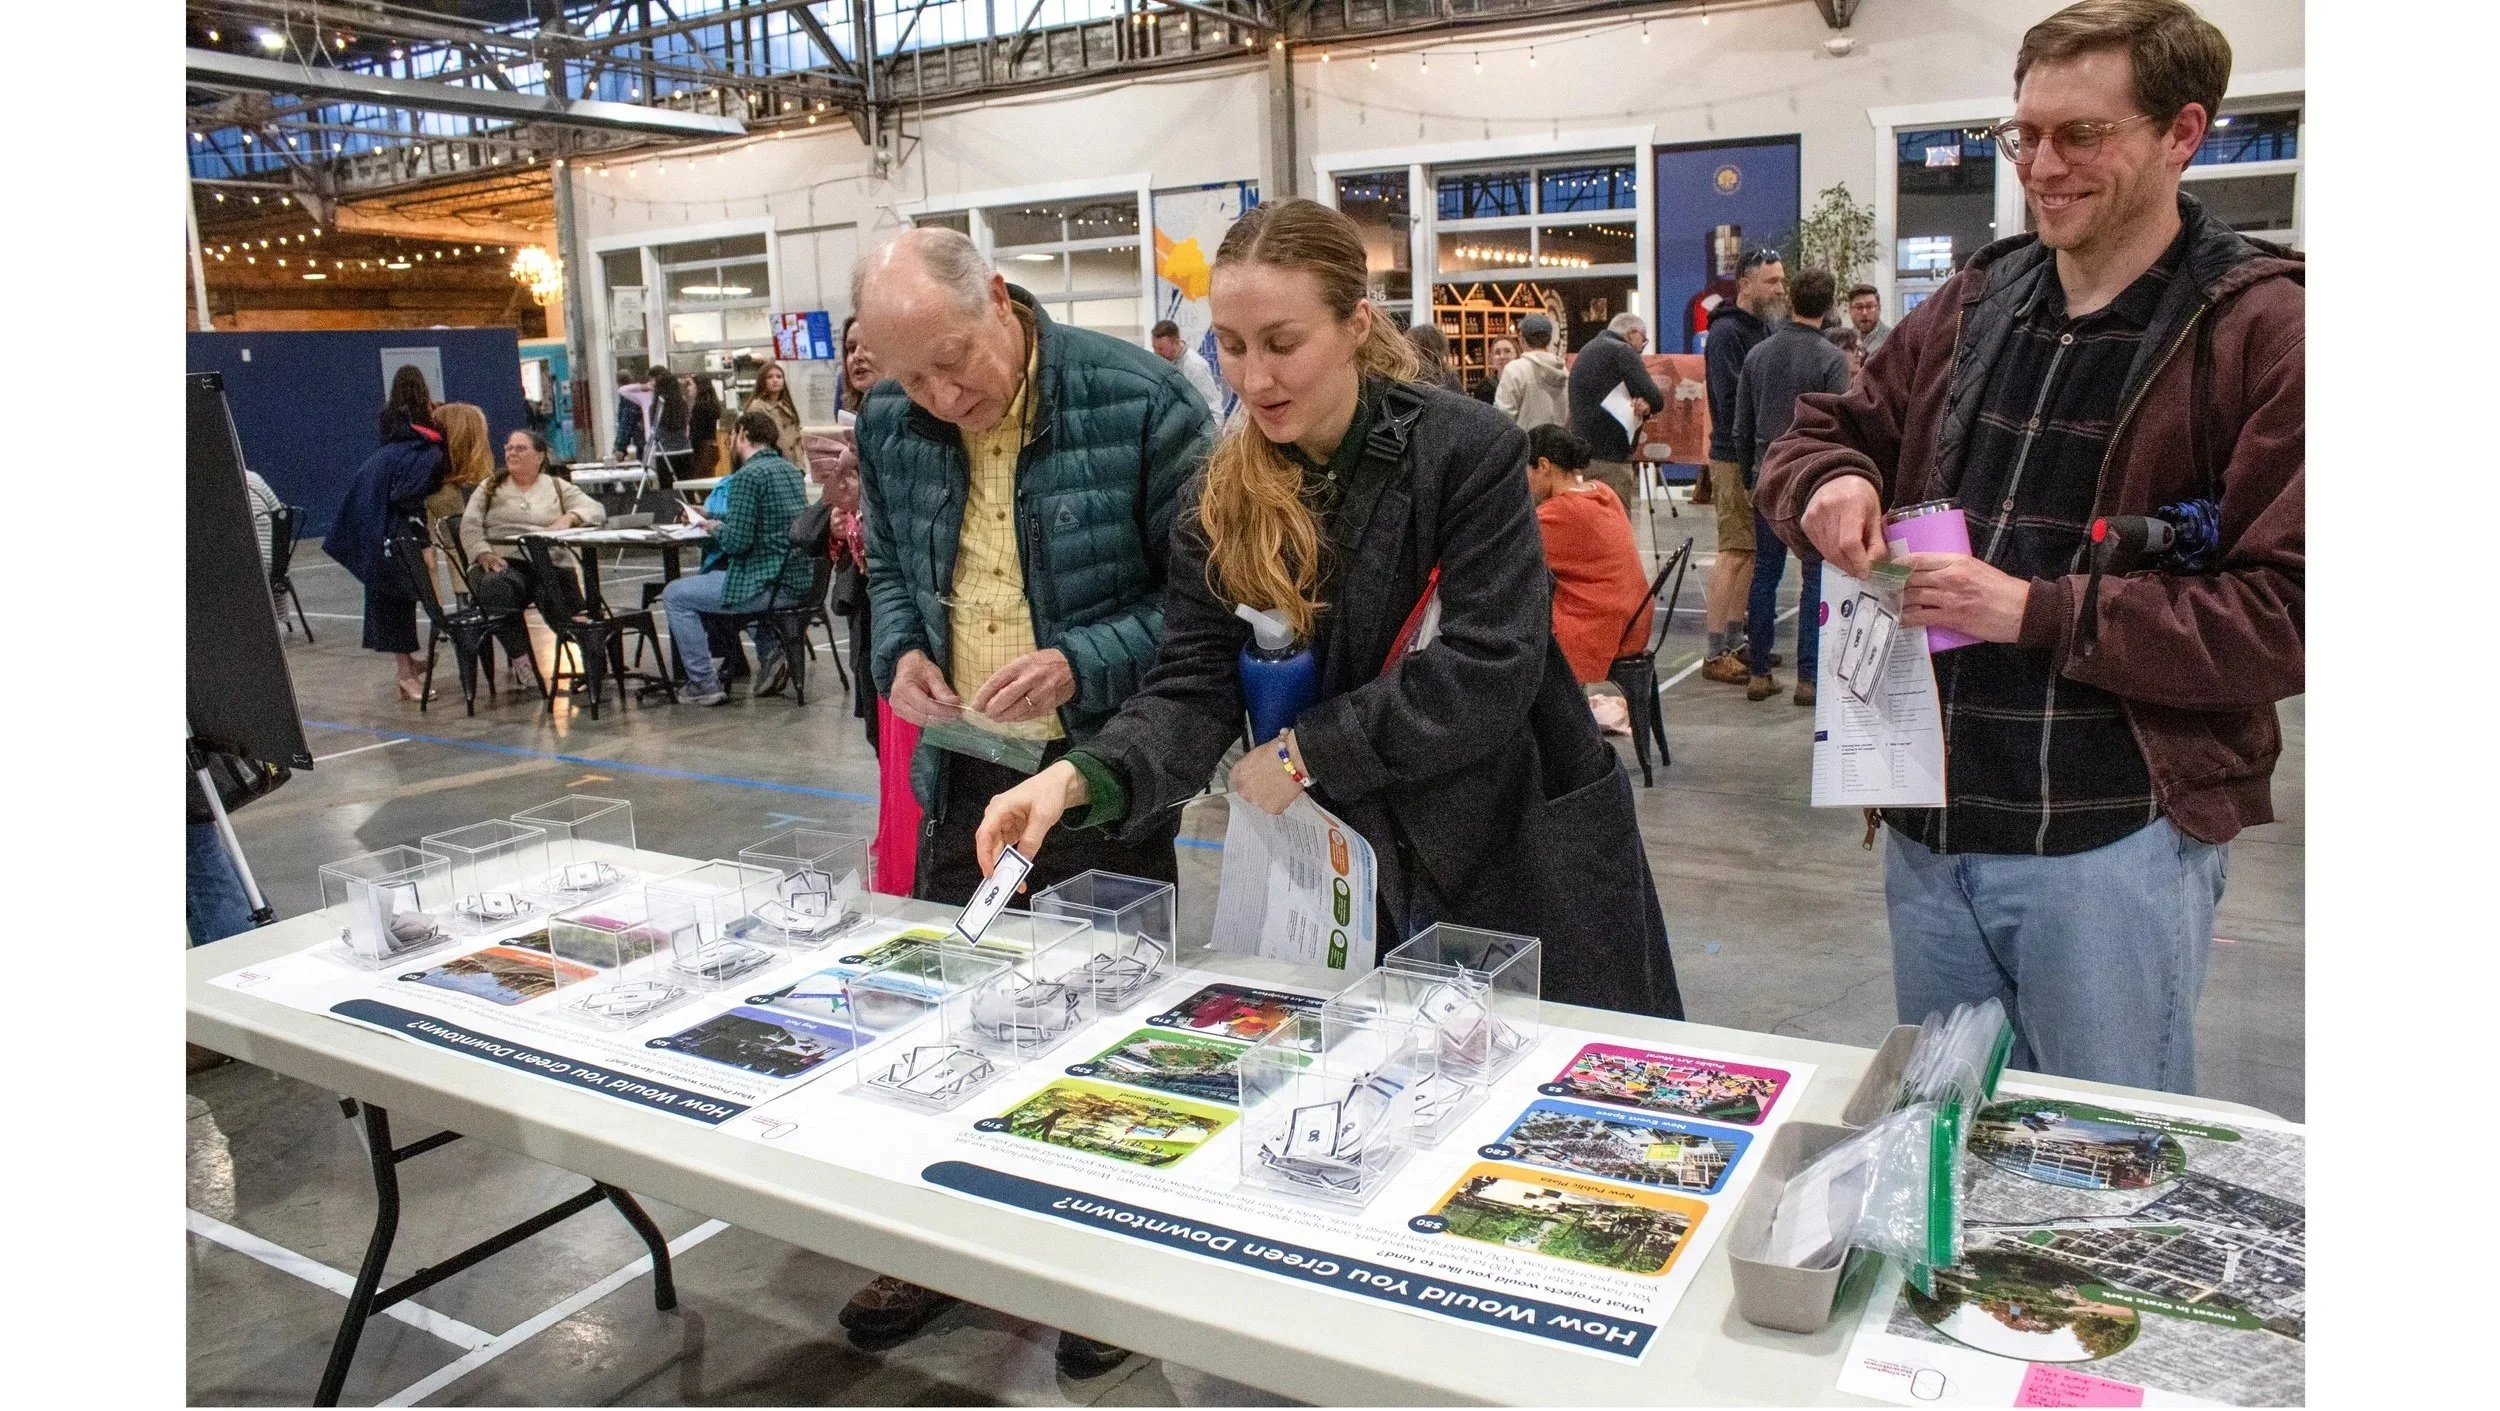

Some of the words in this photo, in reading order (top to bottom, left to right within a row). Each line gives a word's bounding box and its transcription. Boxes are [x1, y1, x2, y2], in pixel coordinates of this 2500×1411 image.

[983, 885, 1001, 907] $10
[1251, 990, 1290, 1000] Sculpture
[1152, 1016, 1172, 1024] $10
[407, 1018, 515, 1058] Downtown?
[513, 1051, 571, 1074] Green
[1646, 1053, 1674, 1061] Mural
[1072, 1066, 1093, 1074] $30
[1695, 1061, 1725, 1069] Public
[570, 1068, 608, 1084] You
[605, 1078, 678, 1104] Would
[1119, 1092, 1170, 1106] Playground
[676, 1097, 734, 1119] How
[1595, 1110, 1626, 1119] Space
[1629, 1116, 1658, 1125] Event
[981, 1121, 1003, 1130] $10
[1661, 1121, 1687, 1129] New
[2163, 1126, 2208, 1136] Refresh
[1485, 1148, 1510, 1156] $80
[1085, 1169, 1111, 1179] With
[1540, 1177, 1569, 1186] Plaza
[1571, 1183, 1605, 1194] Public
[1608, 1190, 1635, 1199] New
[1257, 1209, 1291, 1222] space
[1052, 1196, 1237, 1251] Downtown?
[1294, 1218, 1325, 1230] open
[1415, 1219, 1443, 1229] $50
[1327, 1227, 1351, 1237] and
[1355, 1232, 1382, 1244] park
[1383, 1239, 1426, 1254] toward
[1402, 1234, 1440, 1248] spend
[1429, 1247, 1470, 1263] spend
[1443, 1242, 1483, 1256] would
[1242, 1243, 1340, 1277] Green
[1376, 1249, 1415, 1264] fund?
[1485, 1251, 1518, 1264] YOU
[1419, 1259, 1434, 1267] to
[1437, 1263, 1463, 1274] like
[1490, 1262, 1524, 1275] $100
[1521, 1259, 1549, 1270] how
[1466, 1268, 1493, 1279] you
[1543, 1273, 1574, 1285] total
[1552, 1263, 1613, 1284] prioritize
[1347, 1268, 1411, 1295] You
[1495, 1275, 1539, 1291] would
[1543, 1285, 1602, 1304] Projects
[1591, 1284, 1623, 1296] have
[1626, 1291, 1654, 1302] You
[2101, 1291, 2133, 1302] Park
[1418, 1286, 1537, 1323] Would
[1606, 1300, 1645, 1314] What
[2135, 1298, 2173, 1309] Gratz
[2175, 1305, 2190, 1313] in
[2192, 1308, 2237, 1321] Invest
[1547, 1314, 1637, 1345] How
